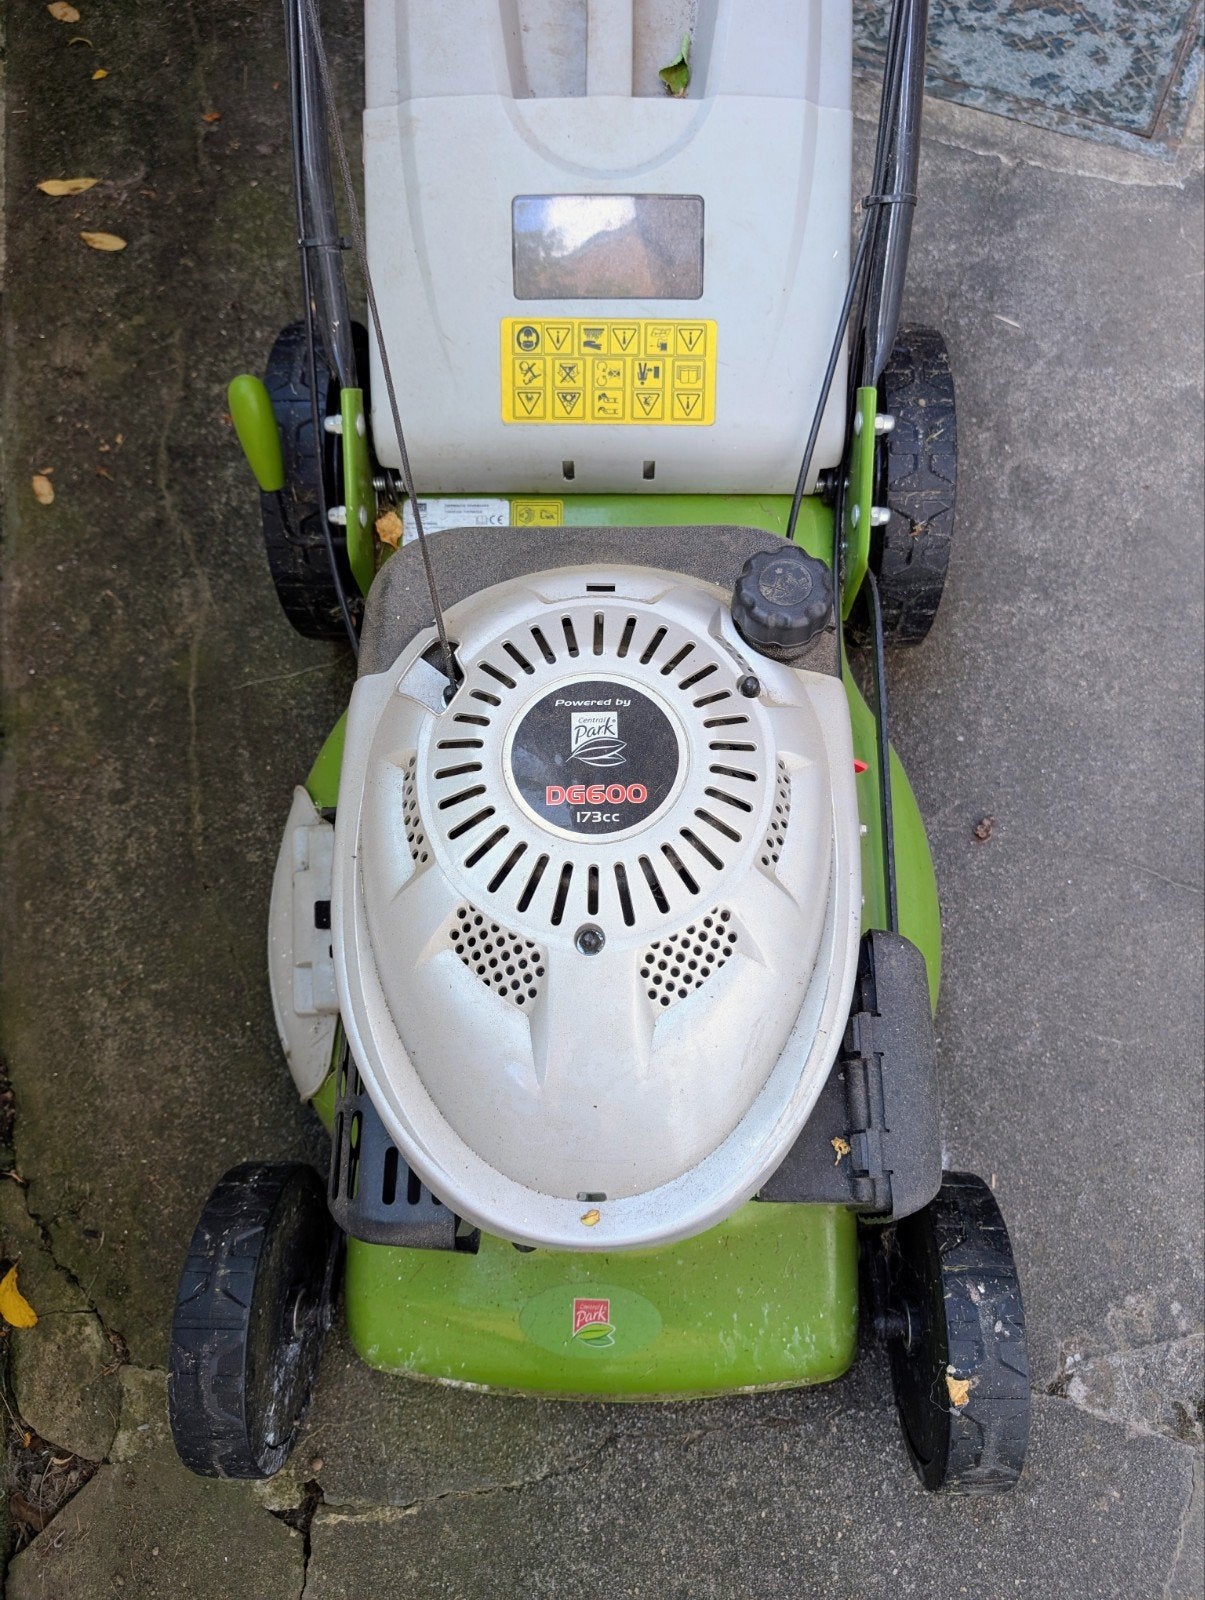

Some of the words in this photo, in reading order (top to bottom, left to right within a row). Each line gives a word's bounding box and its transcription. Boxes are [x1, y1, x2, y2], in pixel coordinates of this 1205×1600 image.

[554, 698, 612, 707] Powered
[615, 698, 632, 707] by
[574, 717, 616, 745] Park
[546, 784, 647, 805] DG600
[576, 811, 620, 823] 173cc
[576, 1304, 607, 1328] Park
